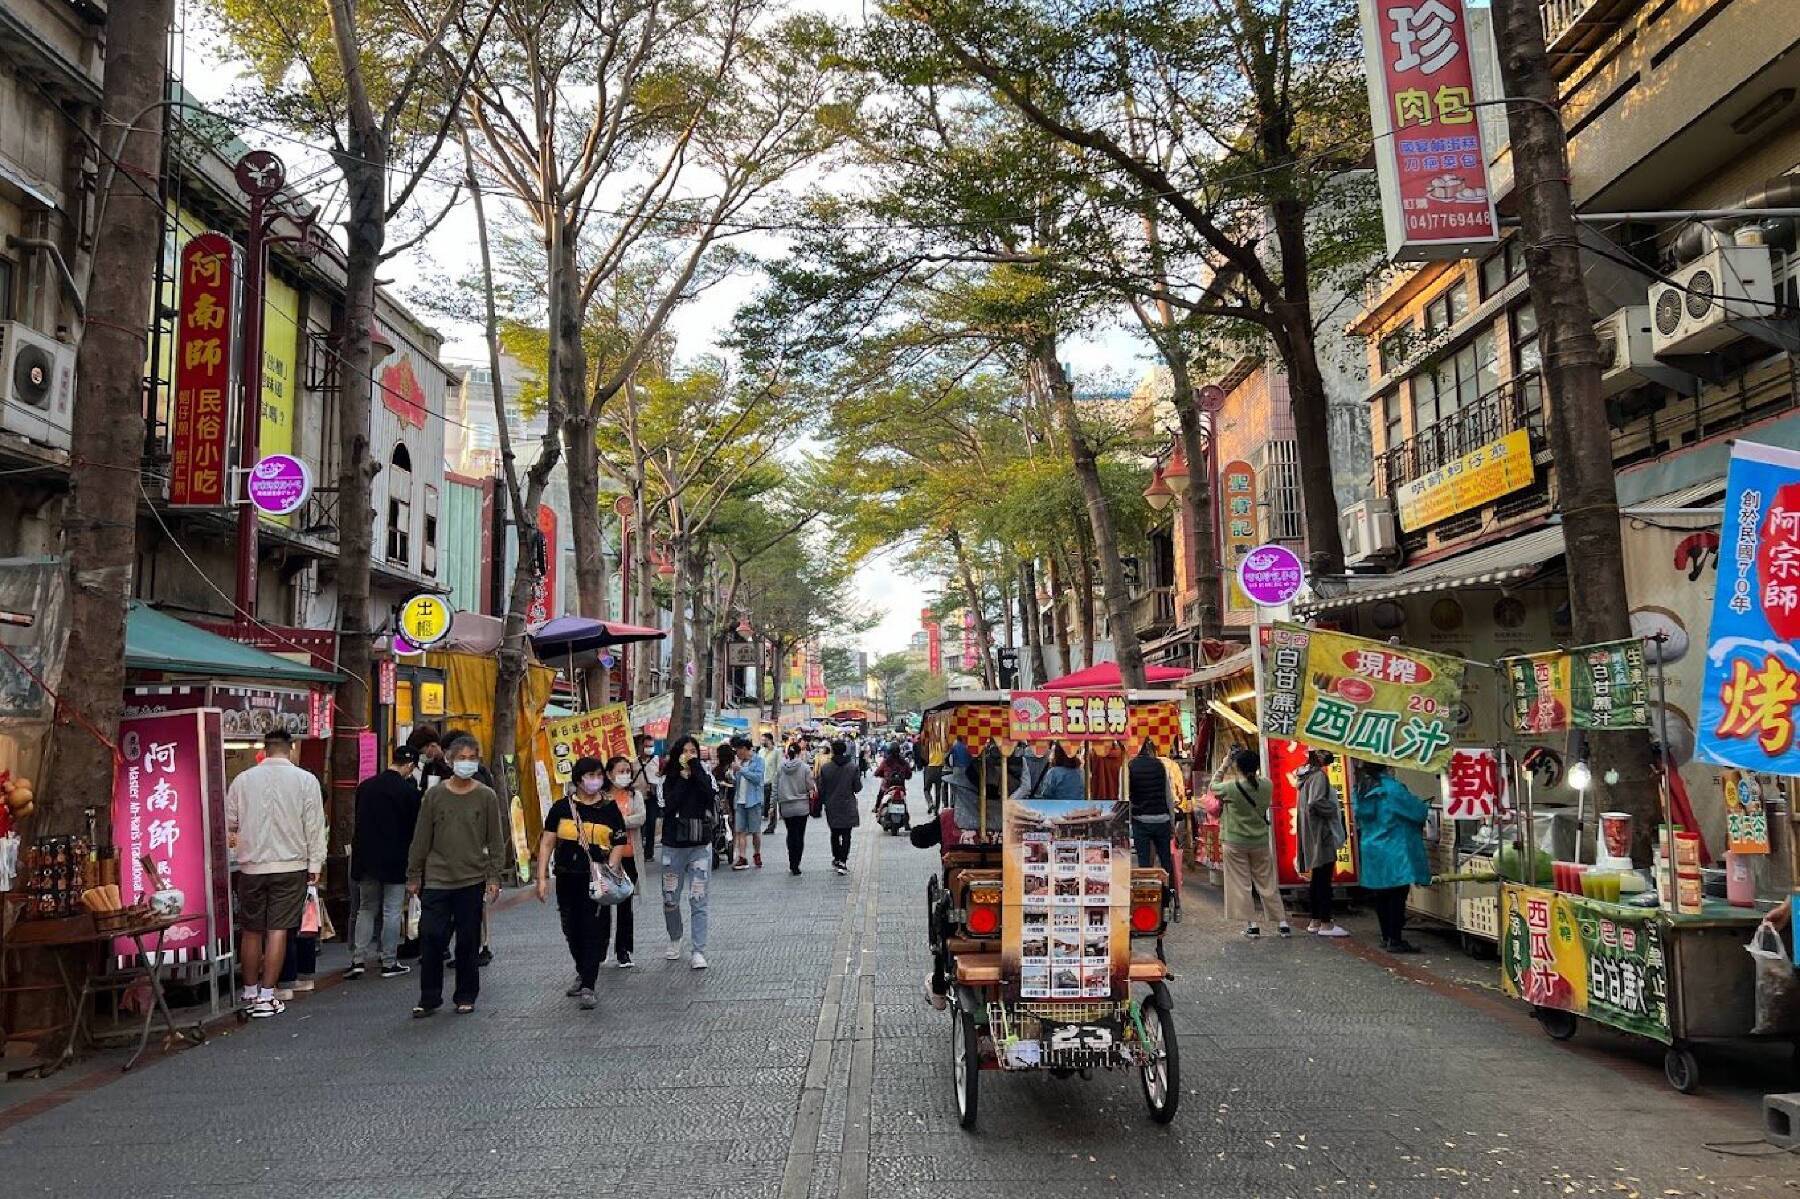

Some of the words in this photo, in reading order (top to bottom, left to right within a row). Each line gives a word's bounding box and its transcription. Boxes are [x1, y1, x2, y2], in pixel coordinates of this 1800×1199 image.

[1387, 0, 1460, 75] 珍
[1394, 84, 1474, 128] 肉包
[1405, 211, 1491, 231] (04)7769448
[184, 250, 227, 376] 阿南師
[193, 388, 222, 495] 民俗小吃
[1762, 505, 1800, 617] 阿宗師
[1269, 648, 1300, 735] 白甘蔗汁
[1354, 649, 1417, 685] 現榨
[1592, 664, 1613, 728] 白甘蔗汁
[1065, 695, 1128, 735] 五倍券
[1304, 695, 1451, 765] 西瓜汁
[1716, 654, 1800, 757] 烤
[128, 766, 141, 799] Master
[143, 741, 181, 859] 阿南師
[1447, 752, 1508, 817] 熱
[1527, 897, 1560, 996] 西瓜汁
[1600, 918, 1637, 951] 巴西
[1052, 1024, 1113, 1050] 23
